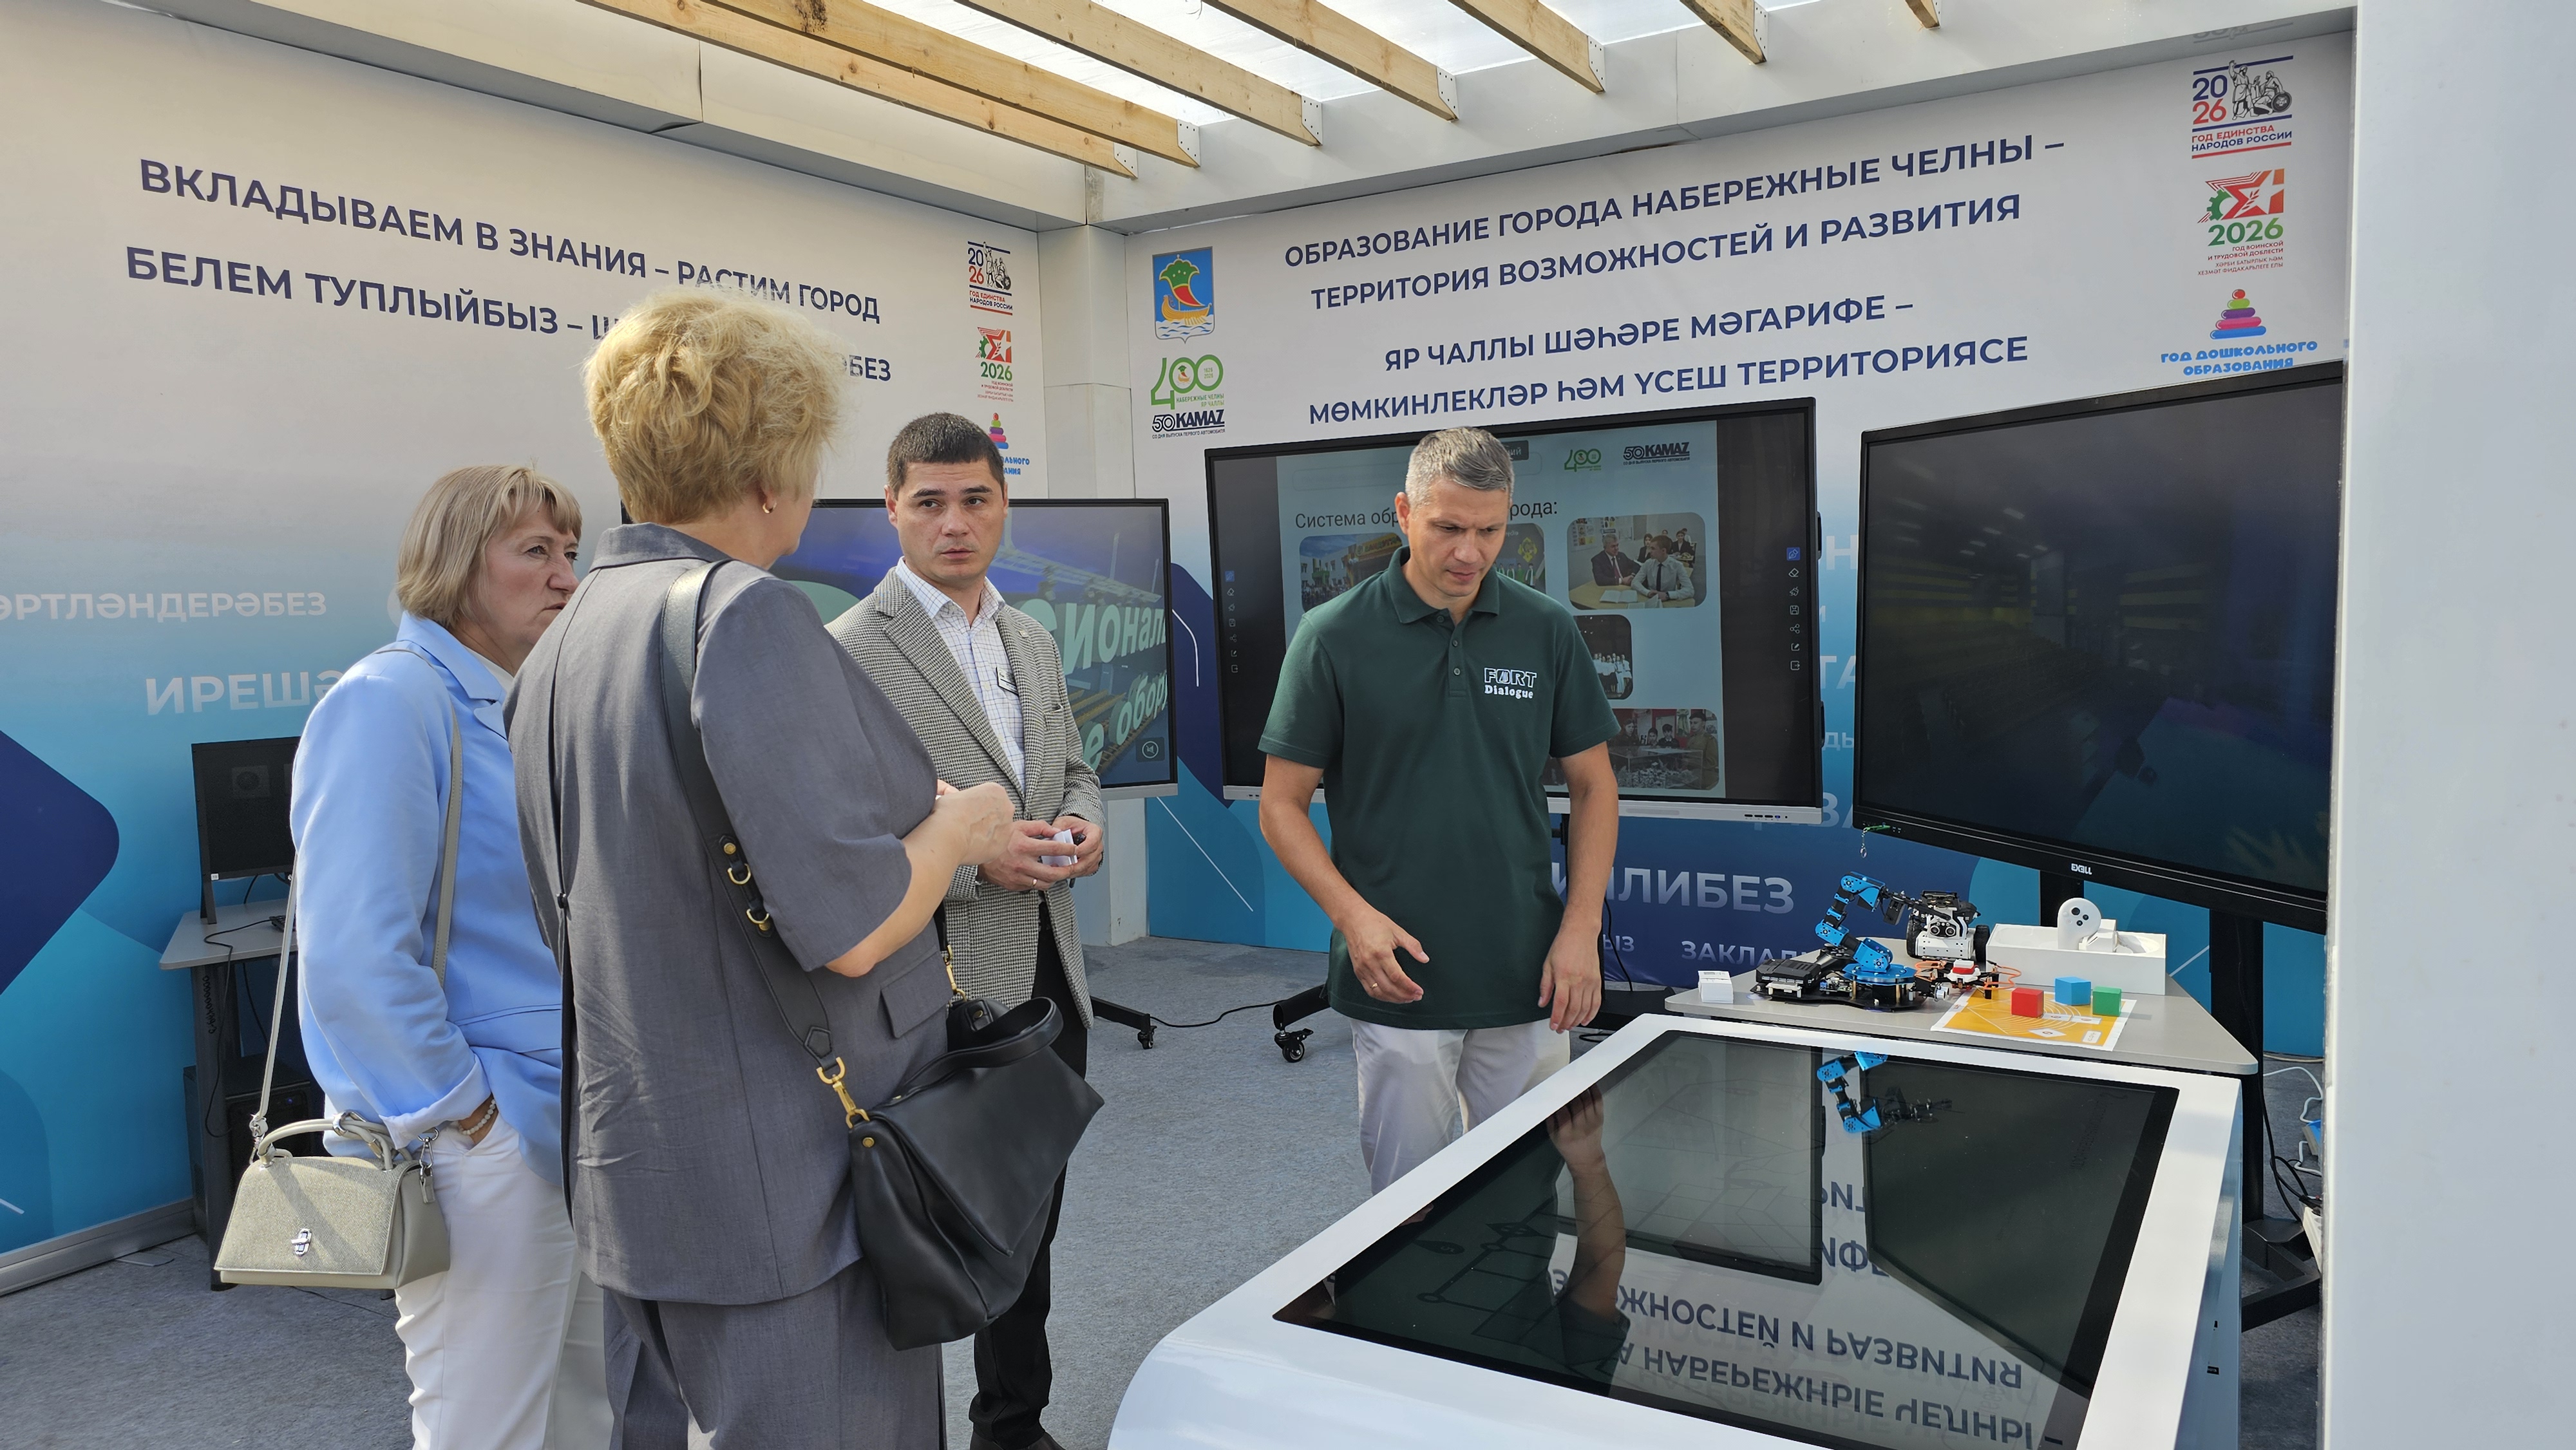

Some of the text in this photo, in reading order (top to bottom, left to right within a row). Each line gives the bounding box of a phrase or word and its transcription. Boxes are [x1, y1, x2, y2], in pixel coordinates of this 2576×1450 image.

[2192, 75, 2228, 101] 20
[2192, 98, 2227, 125] 26
[2192, 124, 2274, 143] ГОД ЕДИНСТВА
[2192, 131, 2292, 151] НАРОДОВ РОССИИ
[1285, 217, 1489, 267] ОБРАЗОВАНИЕ
[1499, 198, 1622, 237] ГОРОДА
[1633, 158, 1879, 217] НАБЕРЕЖНЫЕ
[1891, 135, 2032, 177] ЧЕЛНЫ
[140, 159, 463, 246] ВКЛАДЫВАЕМ
[477, 221, 498, 251] В
[509, 229, 645, 278] ЗНАНИЯ
[678, 261, 790, 304] РАСТИМ
[799, 284, 880, 324] ГОРОД
[2208, 217, 2284, 247] 2026
[1311, 194, 2020, 309] ТЕРРИТОРИЯ ВОЗМОЖНОСТЕЙ И РАЗВИТИЯ
[2214, 251, 2248, 260] ТРУДОВОЙ
[2249, 248, 2284, 256] ДОБЛЕСТИ
[2246, 240, 2284, 250] ВОИНСКОЙ
[968, 247, 983, 267] 20
[969, 265, 984, 285] 26
[127, 246, 292, 299] БЕЛЕМ
[305, 272, 558, 334] ТУПЛЫЙБЫЗ
[980, 293, 1005, 303] ЕДИНСТВА
[970, 297, 992, 306] НАРОДОВ
[1385, 348, 1419, 371] ЯР
[1427, 334, 1534, 366] ЧАЛЛЫ
[1545, 318, 1680, 353] ШӘҺӘРЕ
[1691, 295, 1886, 339] МӘГАРИФЕ
[2161, 341, 2318, 363] ГОД ДОШКОЛЬНОГО
[981, 361, 1012, 381] 2026
[2183, 357, 2293, 375] ОБРАЗОВАНИЯ
[1151, 354, 1224, 410] 400
[1309, 336, 2028, 424] МӨМКИНЛЕКЛӘР ҺӘМ ҮСЕШ ТЕРРИТОРИЯСЕ
[1176, 395, 1207, 403] НАБЕРЕЖНЫЕ
[1003, 457, 1030, 466] ЛЬНОГО
[1564, 449, 1601, 472] 400
[1295, 513, 1365, 528] Система
[1510, 502, 1557, 520] рода:
[1484, 684, 1533, 699] Dialogue
[1681, 940, 1806, 966] ЗАКЛА
